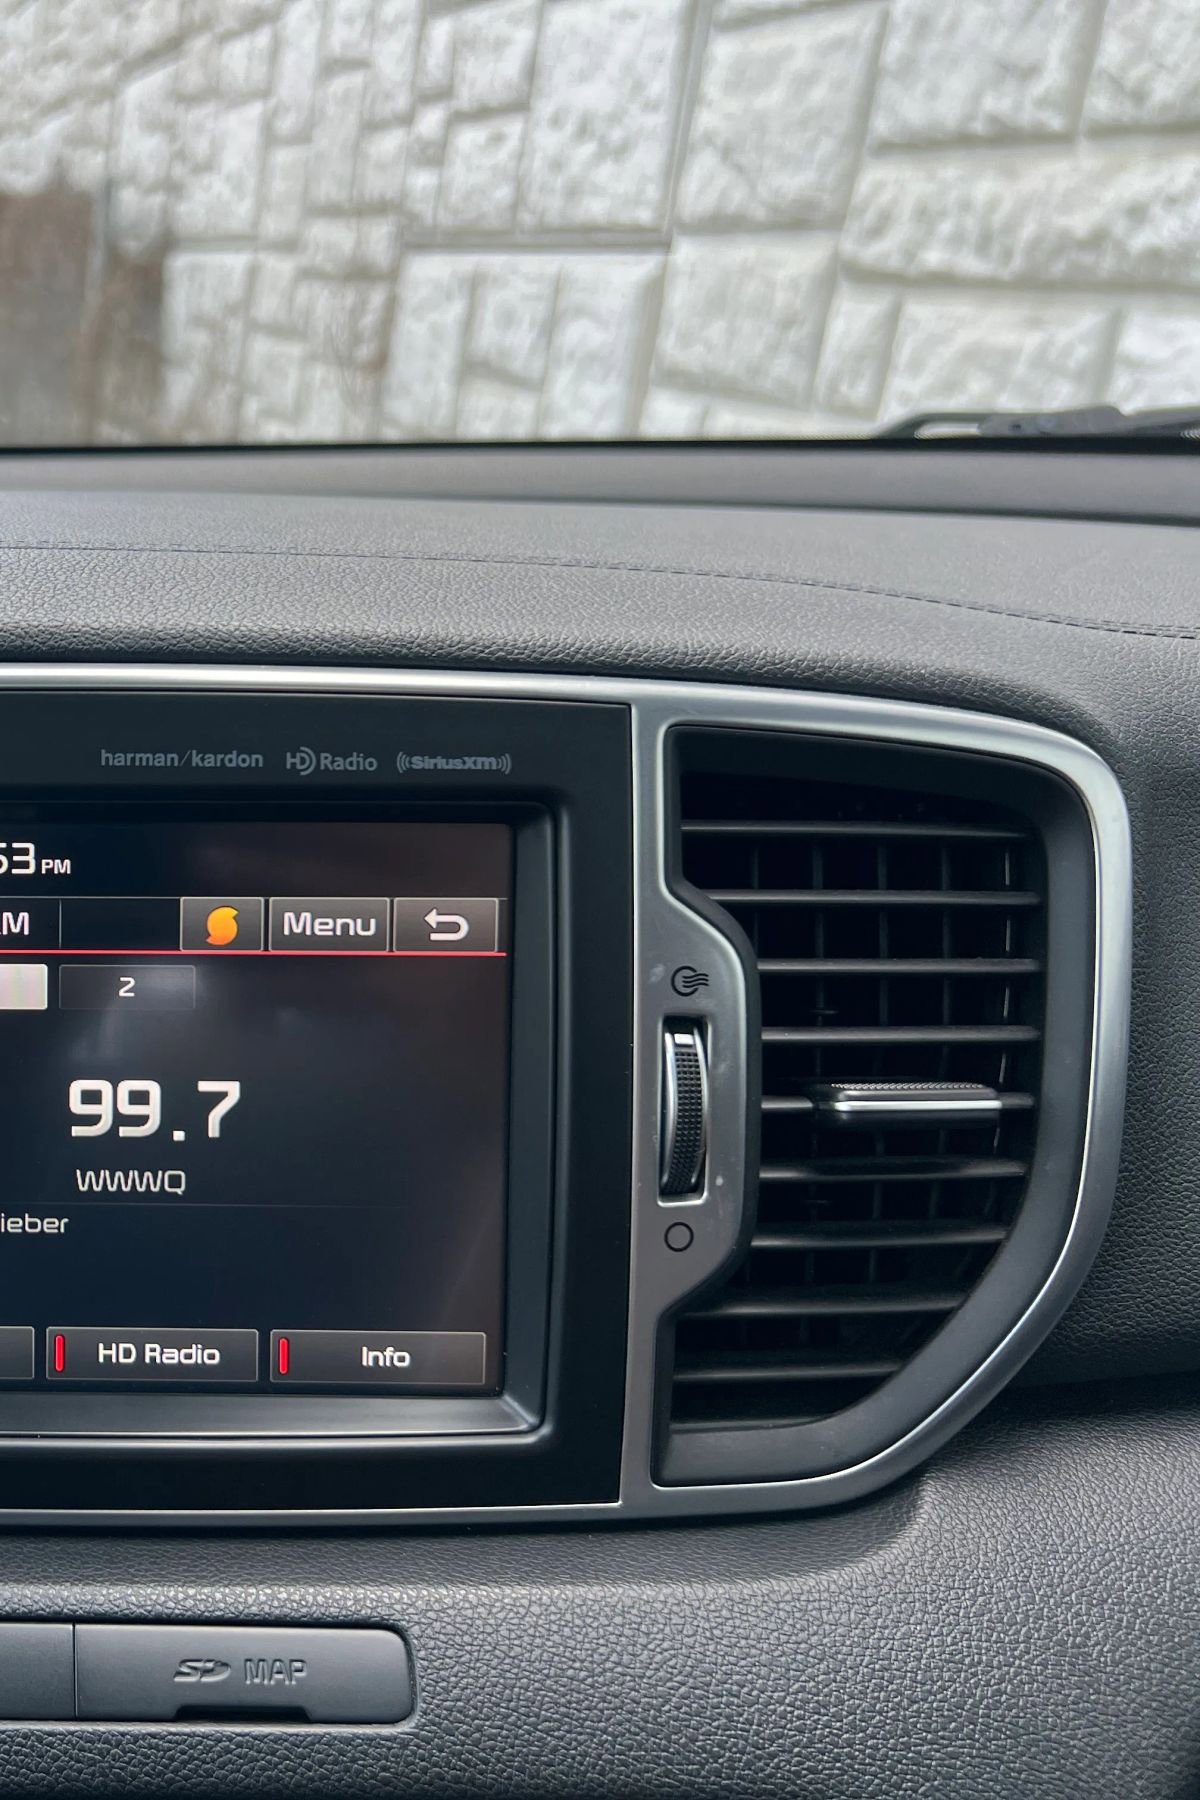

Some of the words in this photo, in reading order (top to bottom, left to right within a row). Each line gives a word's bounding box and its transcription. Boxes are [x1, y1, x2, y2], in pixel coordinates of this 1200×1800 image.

[100, 748, 264, 768] harman/kardon
[319, 753, 378, 771] Radio
[283, 911, 376, 937] Menu
[118, 976, 136, 998] 2
[68, 1079, 242, 1142] 99.7
[76, 1169, 187, 1196] WWWQ
[97, 1343, 136, 1365] HD
[144, 1342, 222, 1367] Radio
[361, 1346, 411, 1369] Info
[244, 1658, 308, 1685] MAP
